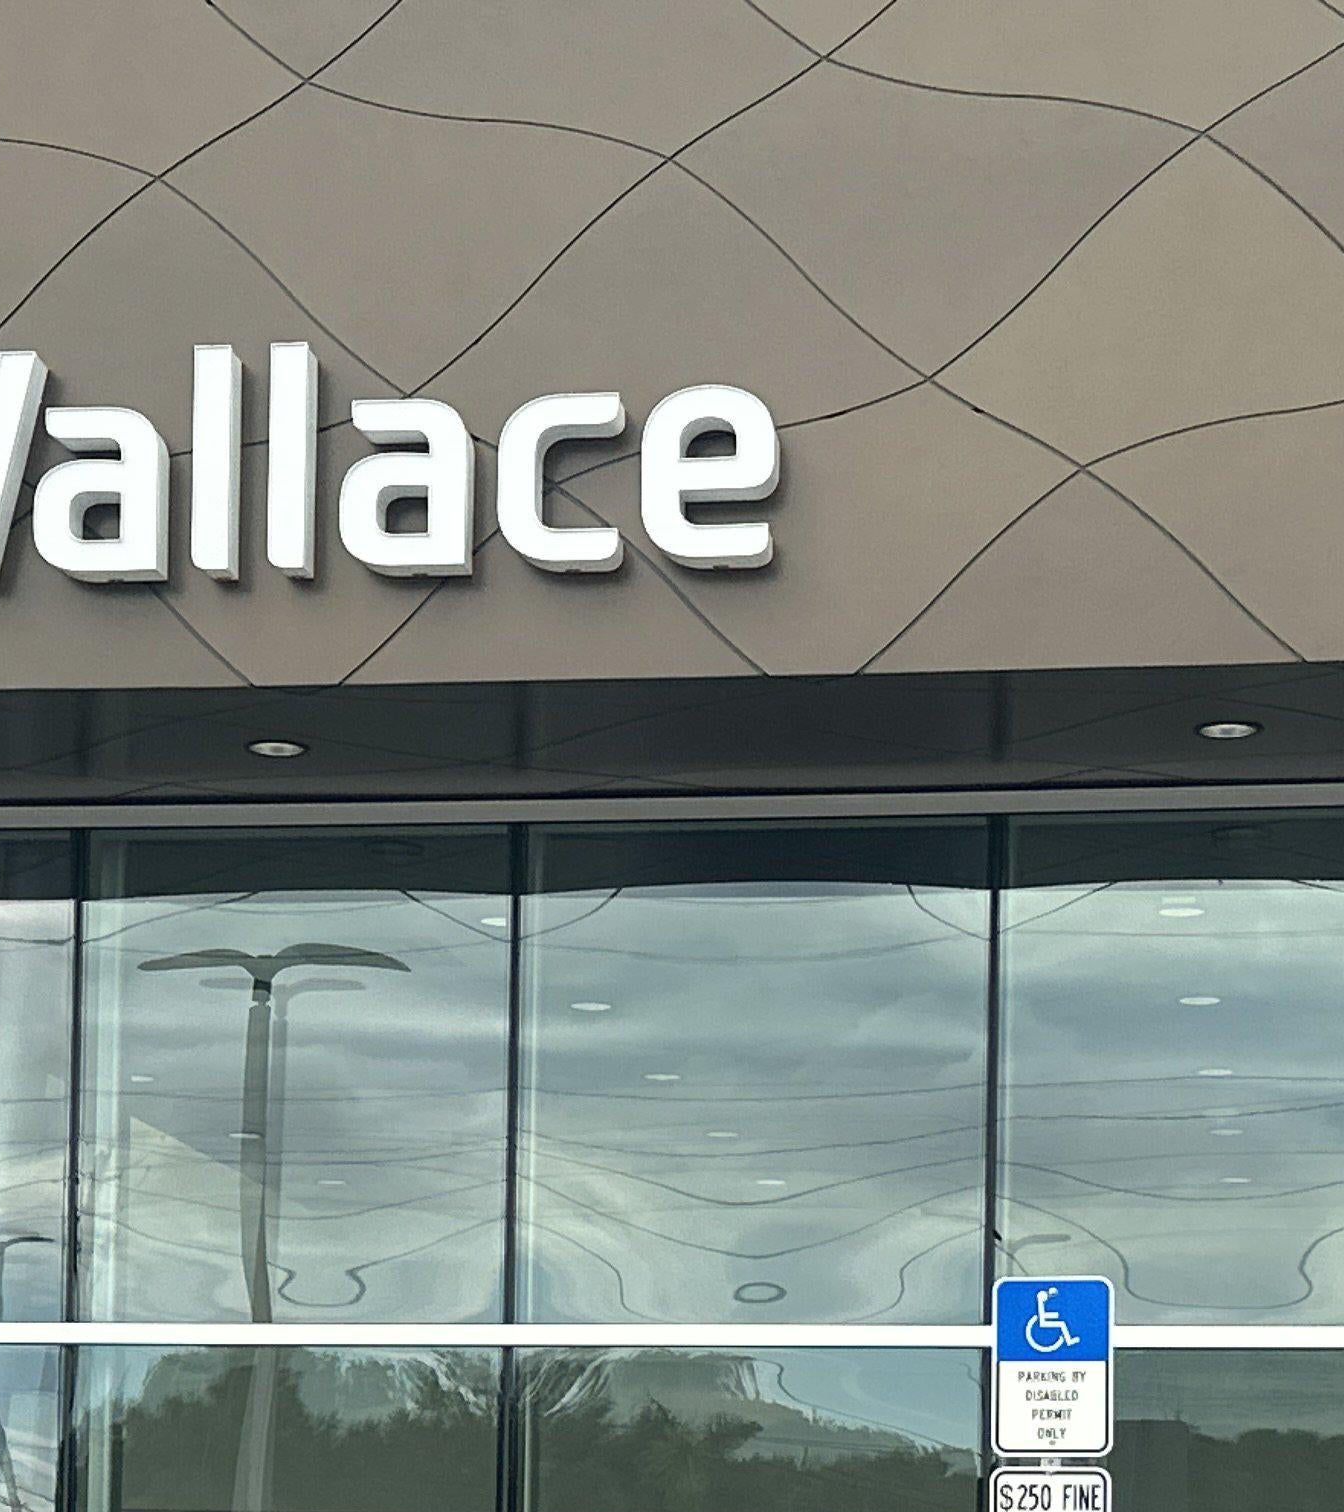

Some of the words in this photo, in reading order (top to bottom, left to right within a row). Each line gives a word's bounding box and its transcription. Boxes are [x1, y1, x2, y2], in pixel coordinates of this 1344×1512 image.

[1017, 1371, 1066, 1383] PARKING
[1071, 1371, 1087, 1383] BY
[1025, 1389, 1079, 1402] DISABLED
[1031, 1408, 1073, 1421] PERMIT
[1037, 1427, 1068, 1440] ONLY
[999, 1483, 1052, 1512] $250
[1062, 1483, 1102, 1511] FINE
